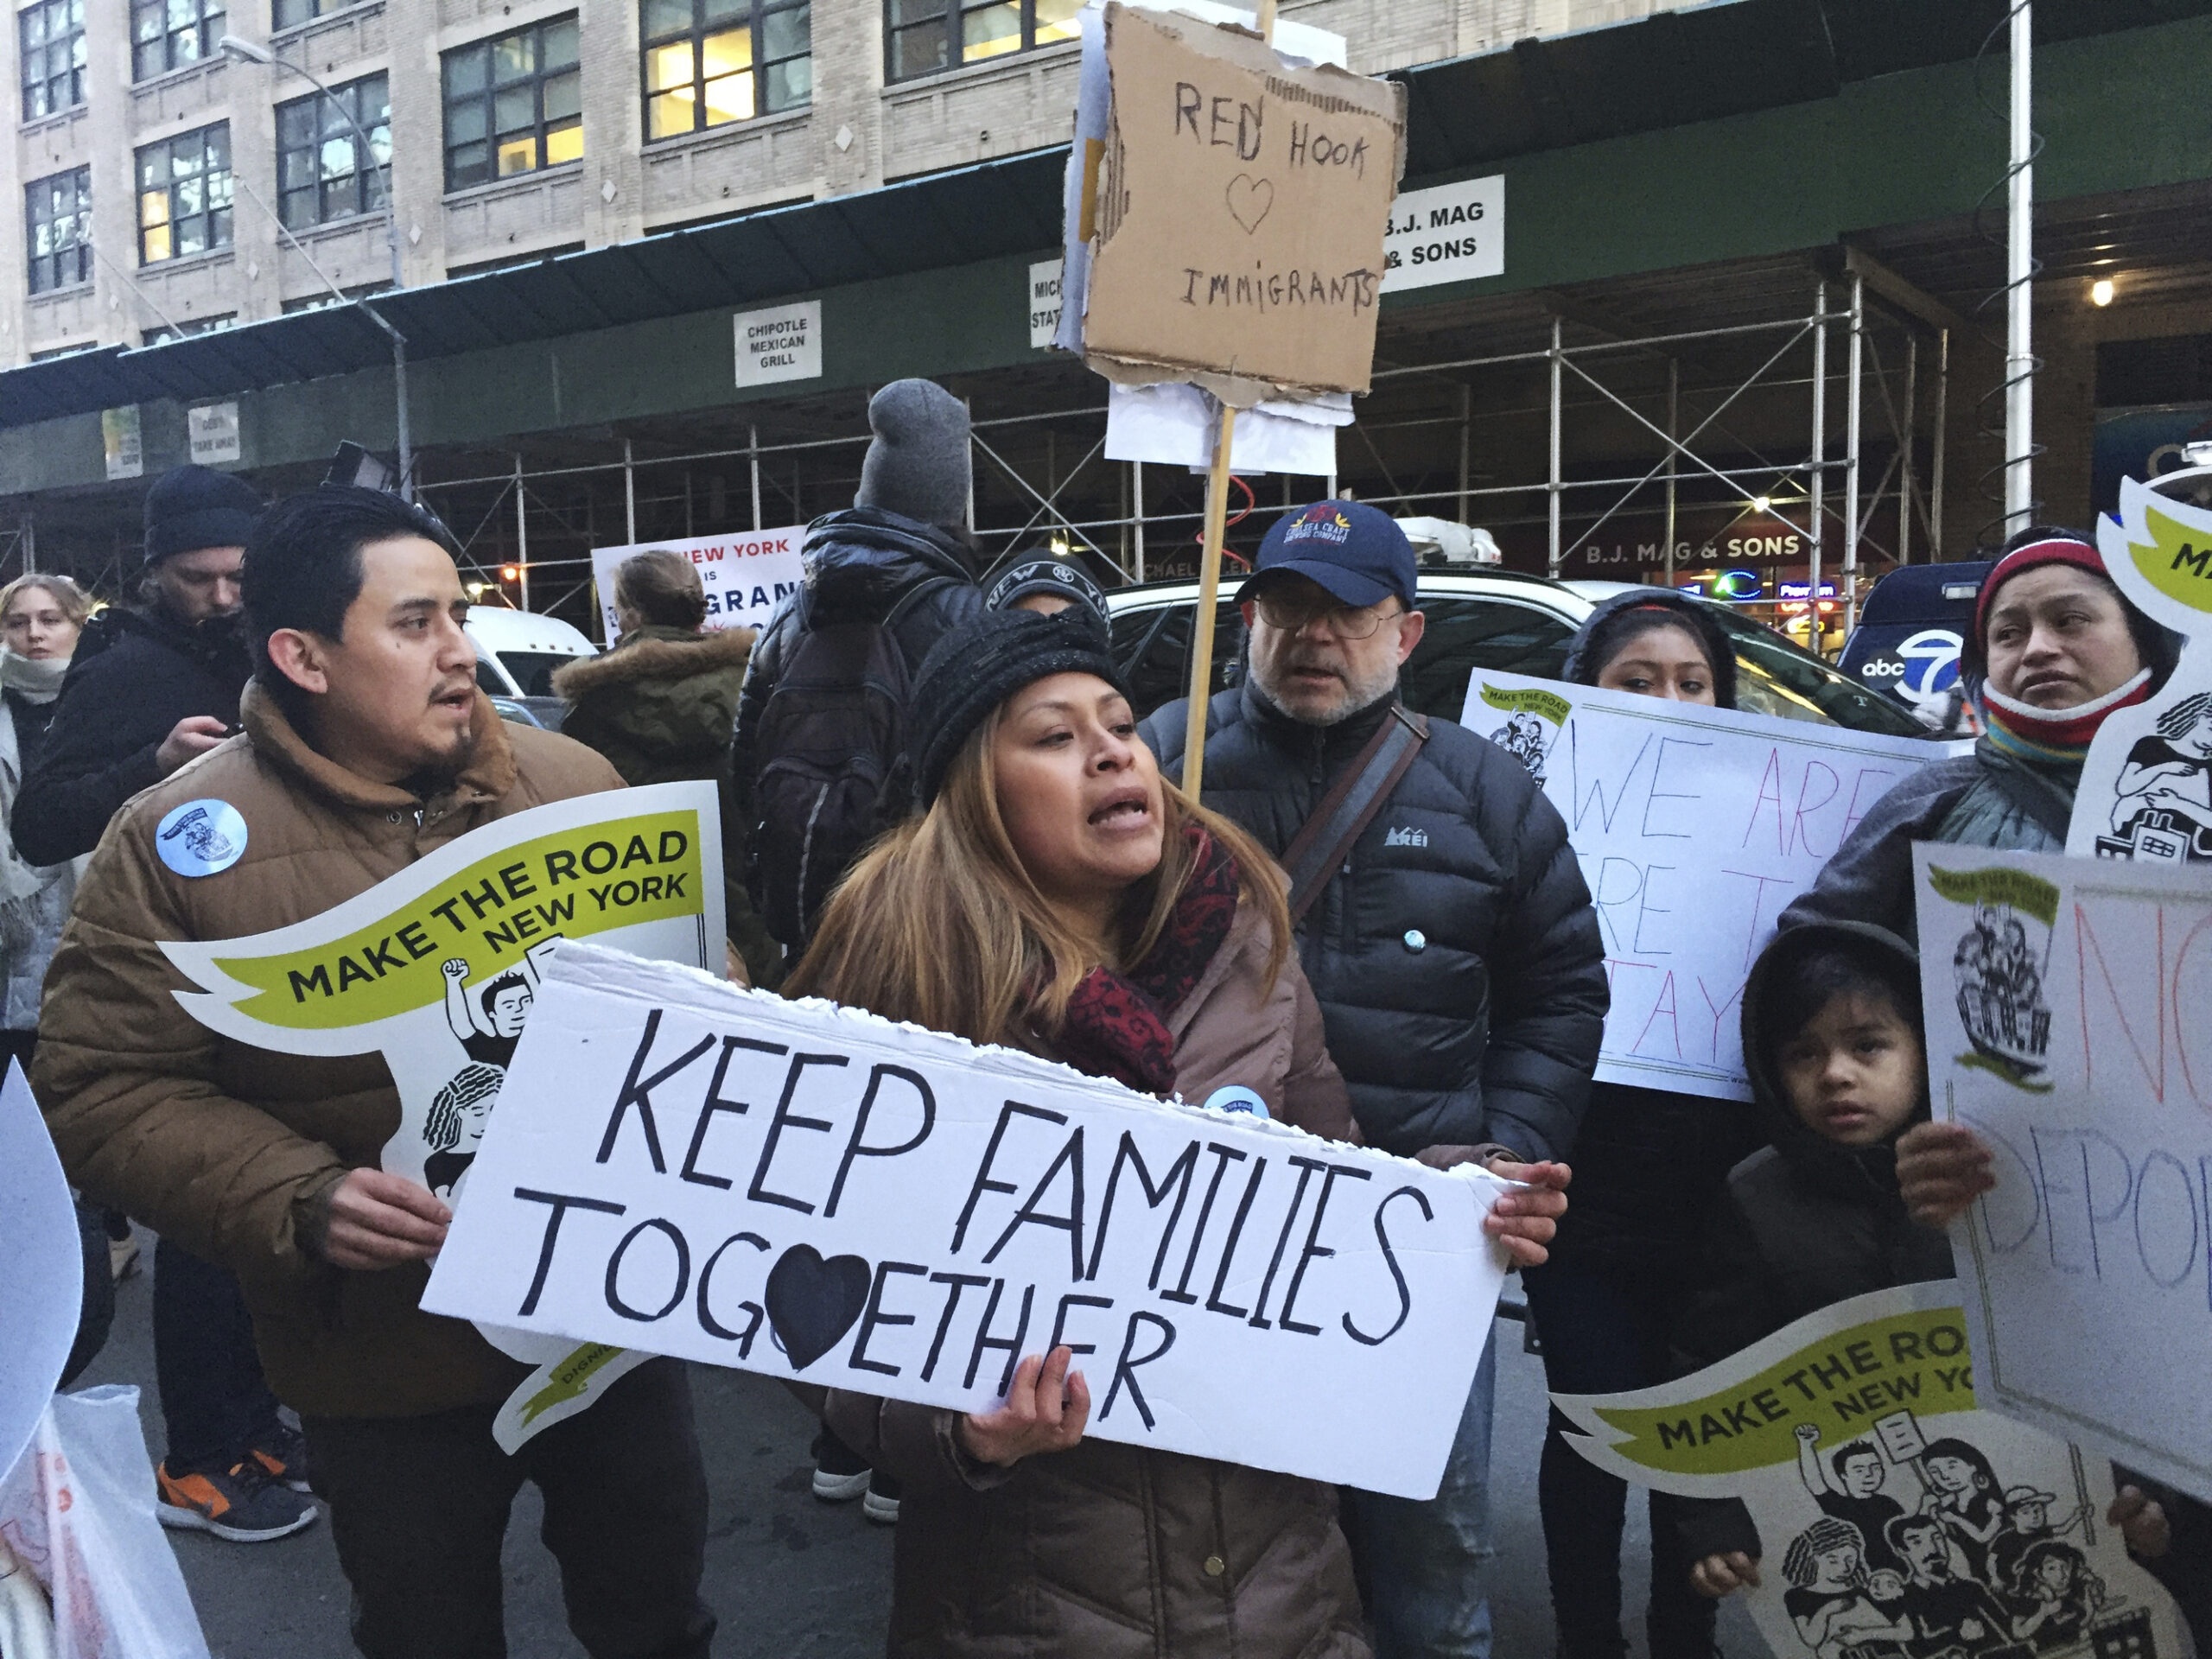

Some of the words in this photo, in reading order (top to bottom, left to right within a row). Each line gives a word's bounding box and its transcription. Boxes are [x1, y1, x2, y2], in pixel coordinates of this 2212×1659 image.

[1175, 82, 1264, 161] RED
[1290, 123, 1370, 180] HOOK
[1431, 202, 1484, 228] MAG
[1412, 238, 1478, 265] SONS
[1181, 262, 1378, 317] IMMIGRANTS
[747, 318, 808, 338] CHIPOTLE
[750, 335, 805, 354] MEXICAN
[760, 353, 796, 368] GRILL
[733, 538, 790, 558] YORK
[1586, 544, 1630, 564] B.J.
[1700, 541, 1719, 560] &
[1728, 535, 1801, 558] SONS
[704, 571, 717, 582] IS
[1862, 658, 1906, 677] abc
[1489, 690, 1518, 702] MAKE
[1519, 692, 1541, 701] THE
[1541, 694, 1568, 714] ROAD
[1570, 719, 1713, 838] WE
[1400, 834, 1428, 848] REI
[286, 921, 438, 1003] MAKE
[429, 861, 537, 934] THE
[543, 830, 688, 887] ROAD
[481, 893, 576, 955] NEW
[587, 872, 689, 913] YORK
[1601, 958, 1747, 1064] TAY
[594, 1008, 936, 1217] KEEP
[950, 1099, 1435, 1347] FAMILIES
[1958, 1115, 2212, 1313] DEPO
[562, 1344, 613, 1384] DIGNI
[1656, 1389, 1789, 1451] MAKE
[1781, 1343, 1884, 1402] THE
[1889, 1325, 1966, 1363] RO
[1831, 1371, 1922, 1424] NEW
